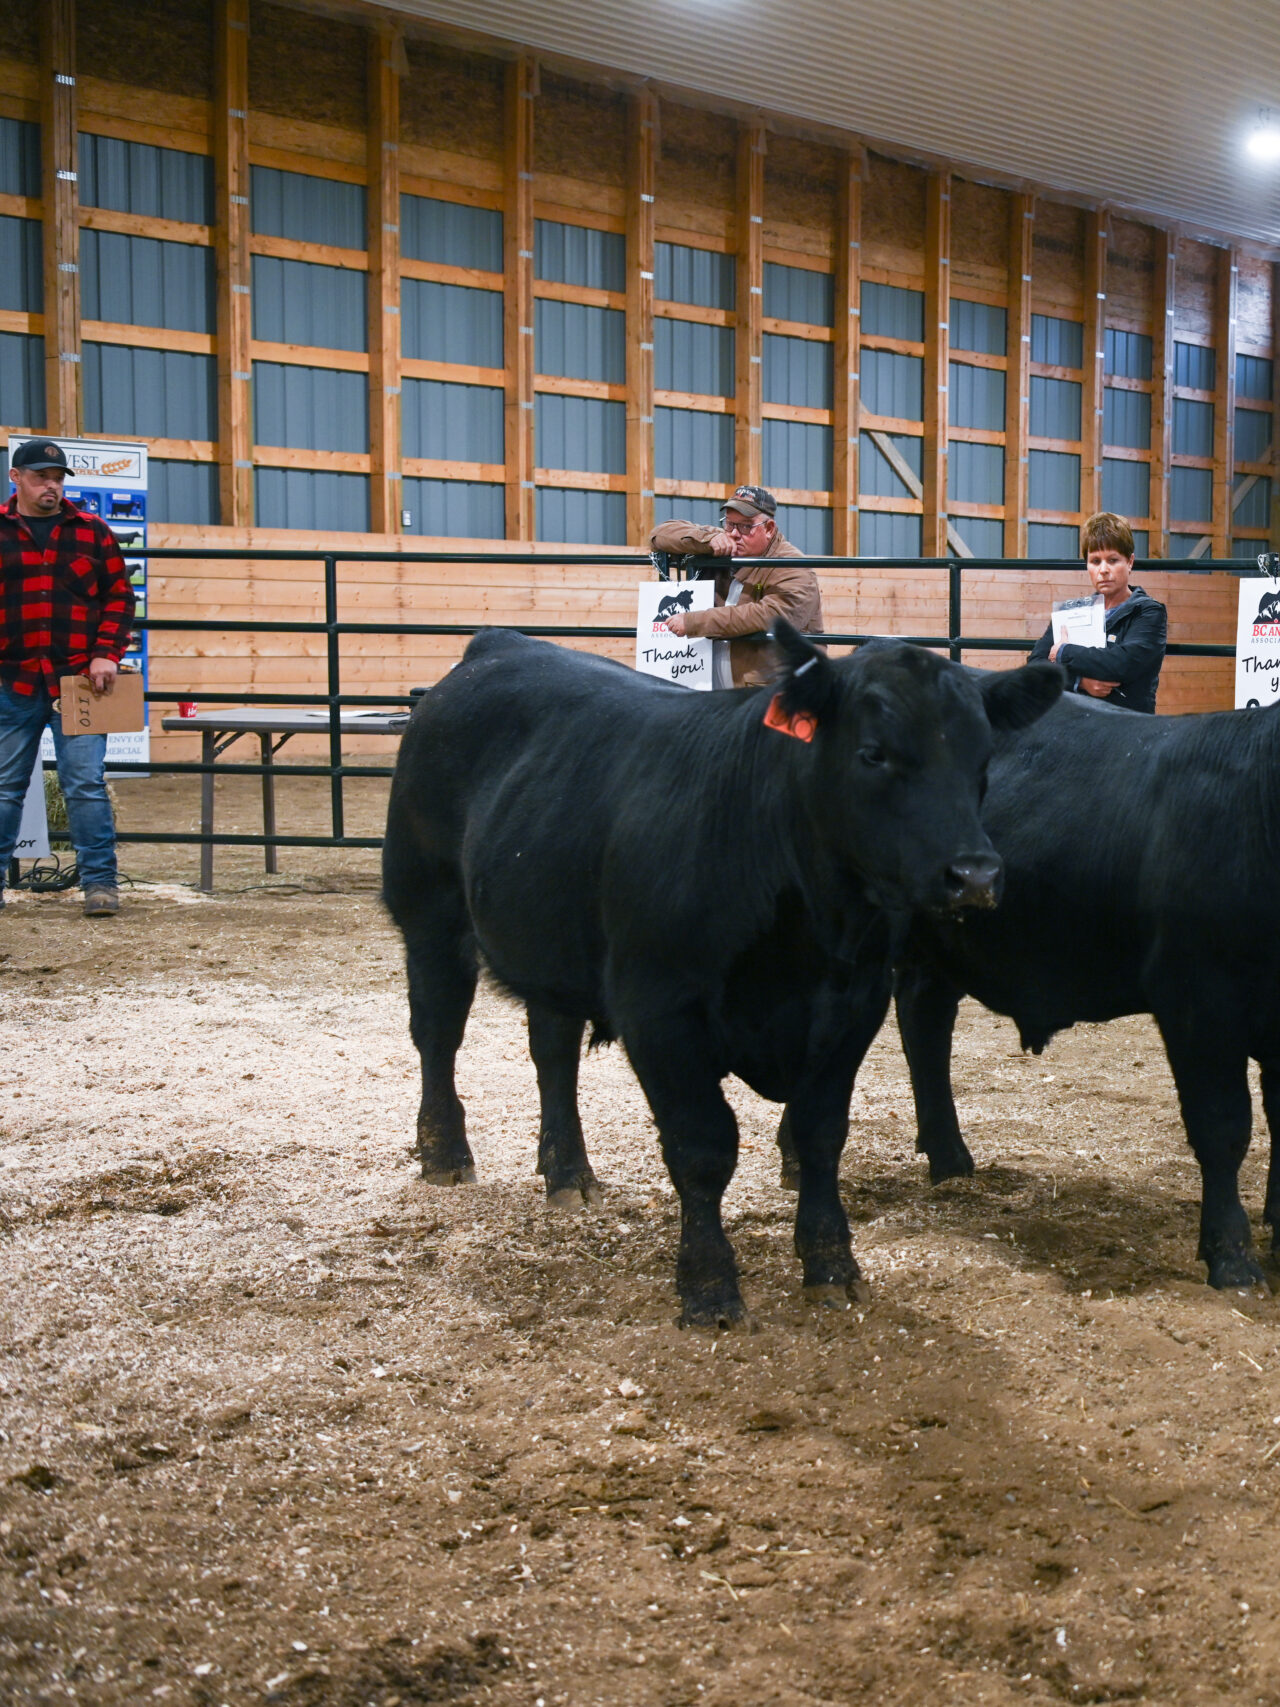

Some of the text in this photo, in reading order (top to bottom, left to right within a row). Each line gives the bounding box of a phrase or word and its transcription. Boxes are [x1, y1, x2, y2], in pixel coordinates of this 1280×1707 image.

[1252, 625, 1268, 637] BC
[642, 644, 698, 663] Thank
[671, 658, 705, 679] you!
